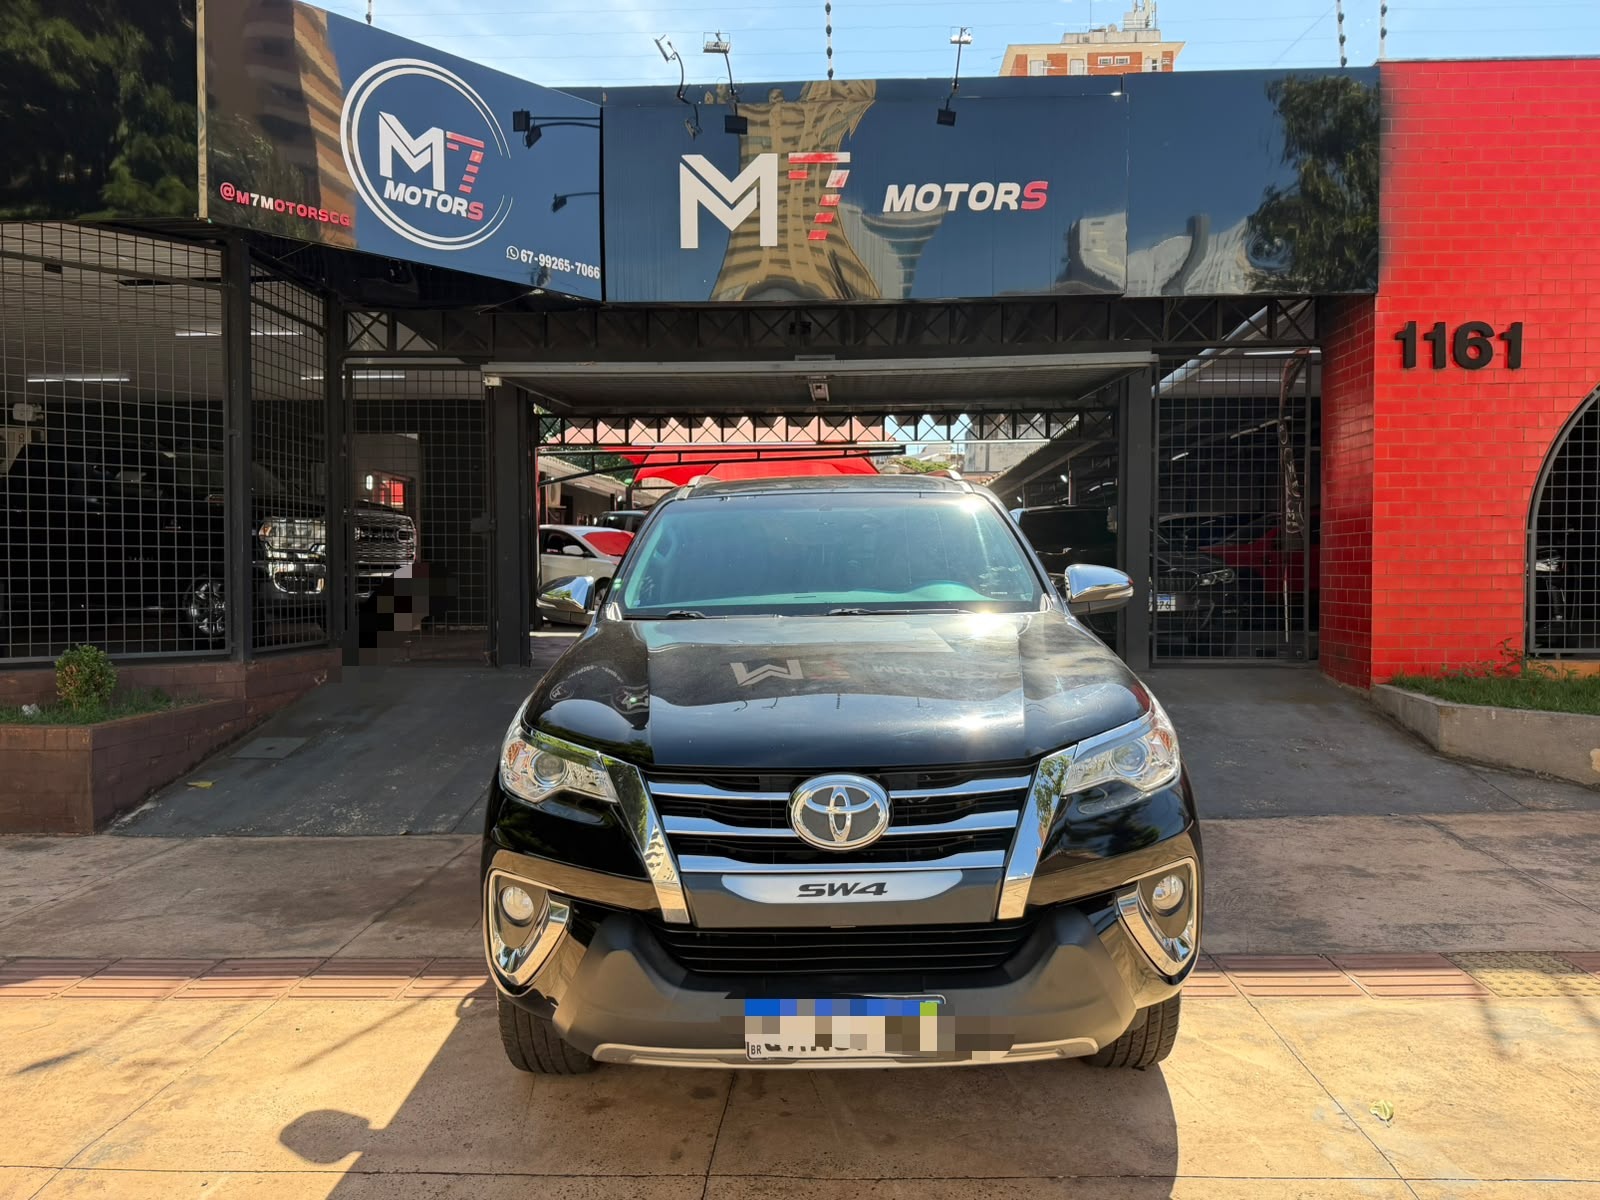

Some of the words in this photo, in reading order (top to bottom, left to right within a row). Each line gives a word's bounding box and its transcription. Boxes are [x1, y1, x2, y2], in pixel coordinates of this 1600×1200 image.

[379, 110, 485, 193] M7
[219, 182, 351, 227] @M7MOTORSCG
[383, 179, 484, 222] MOTORS
[679, 152, 851, 249] M7
[882, 180, 1049, 213] MOTORS
[520, 249, 600, 280] 67-99265-7066
[1394, 321, 1523, 370] 1161
[796, 882, 889, 898] SW4
[750, 1044, 762, 1055] BR
